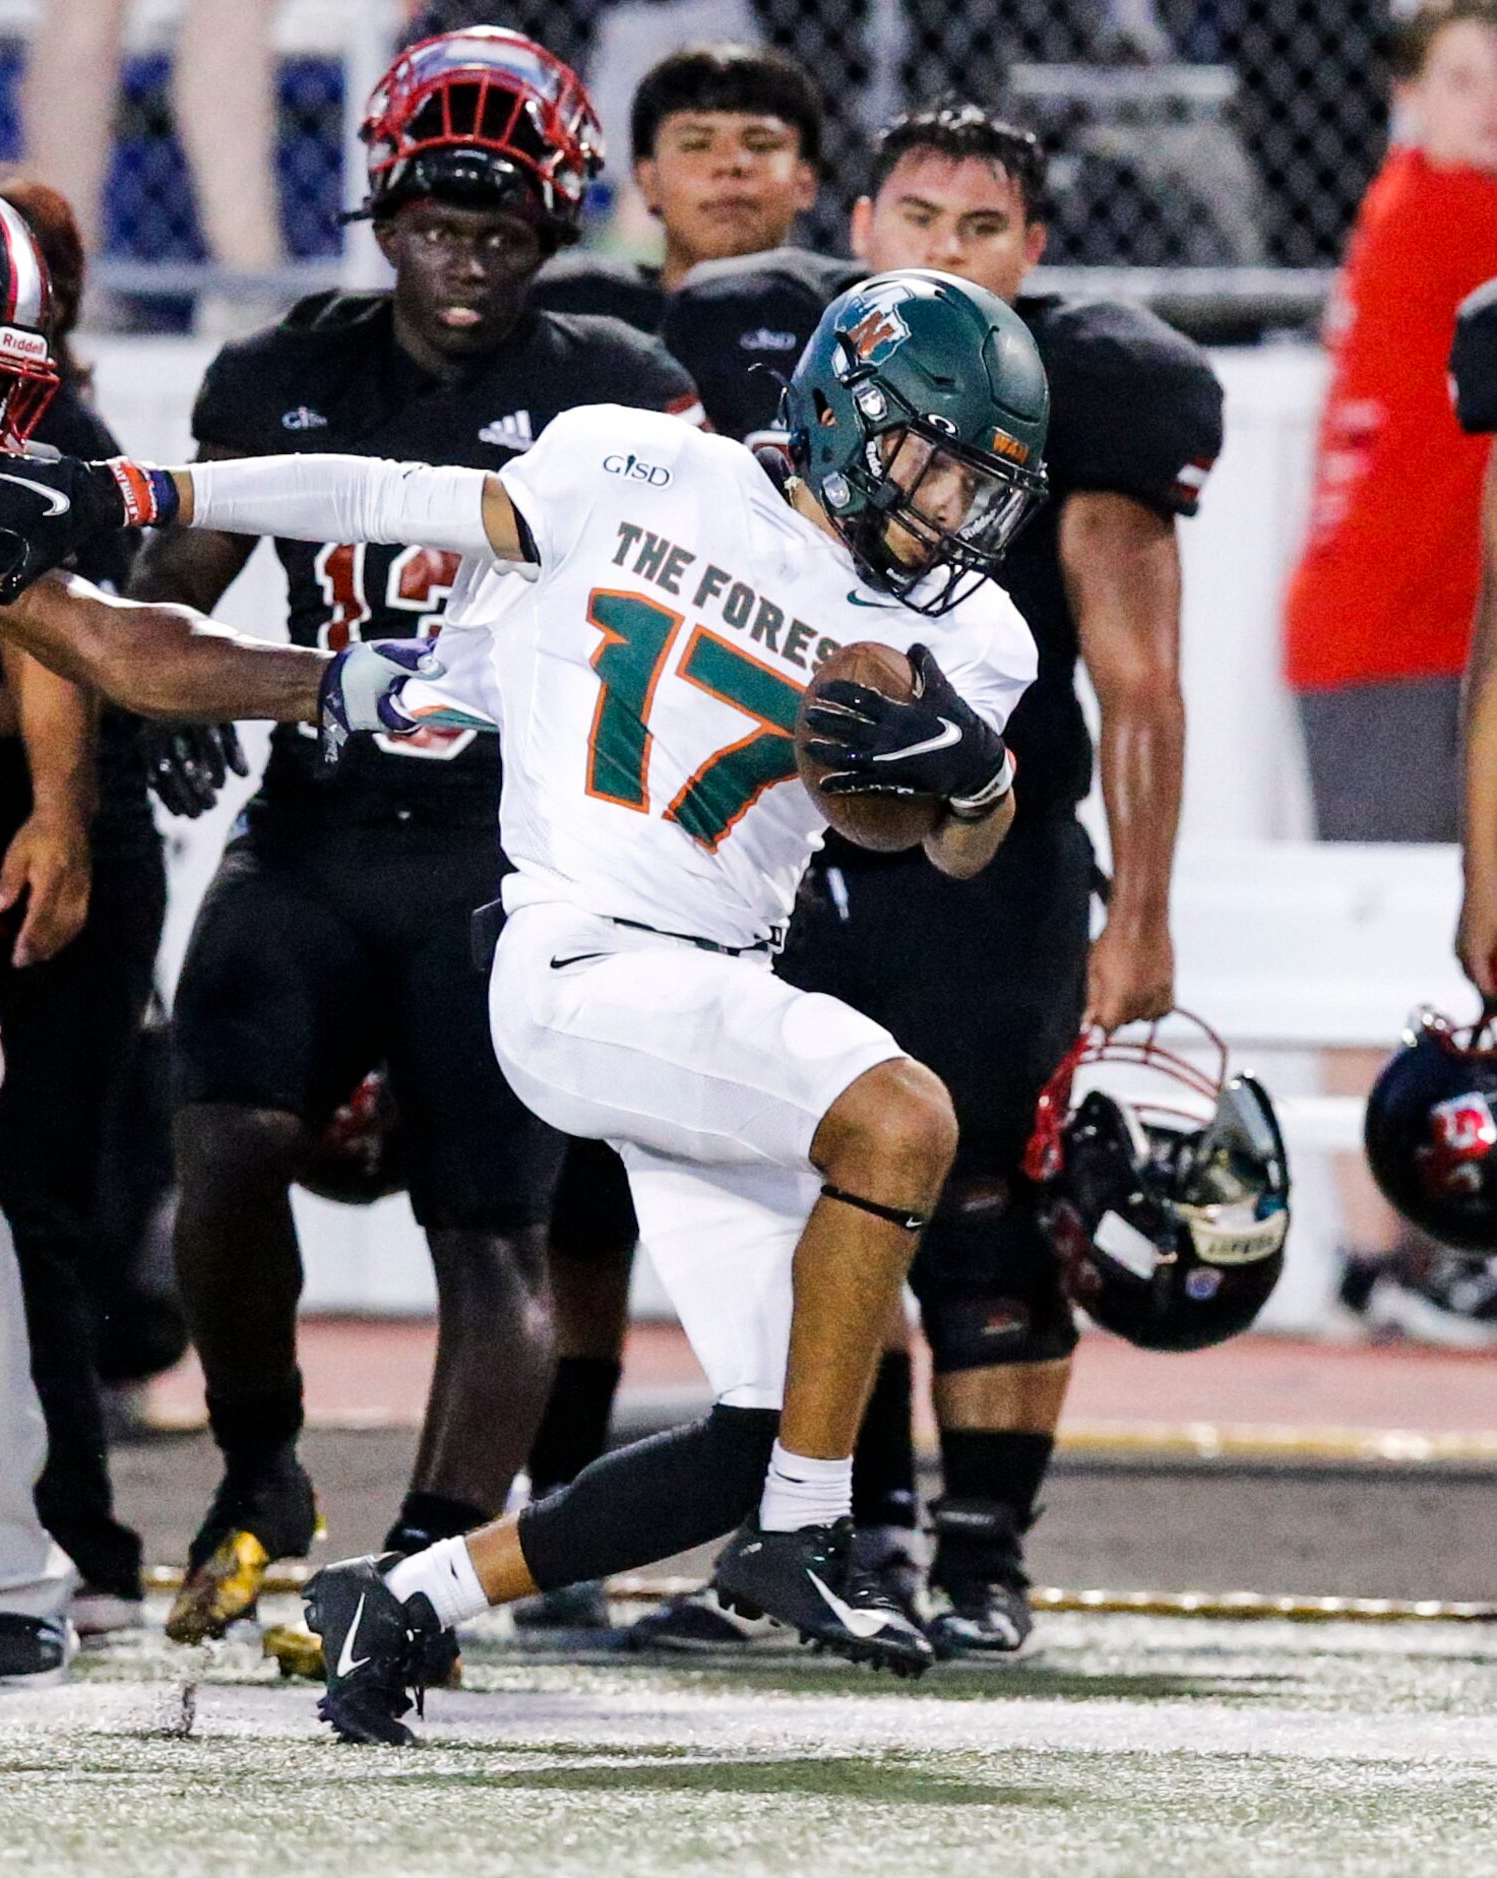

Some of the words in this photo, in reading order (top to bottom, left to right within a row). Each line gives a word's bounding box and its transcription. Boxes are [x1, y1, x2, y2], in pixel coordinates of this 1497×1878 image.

[602, 453, 671, 487] GISD
[611, 520, 697, 595] THE
[585, 587, 808, 855] 17
